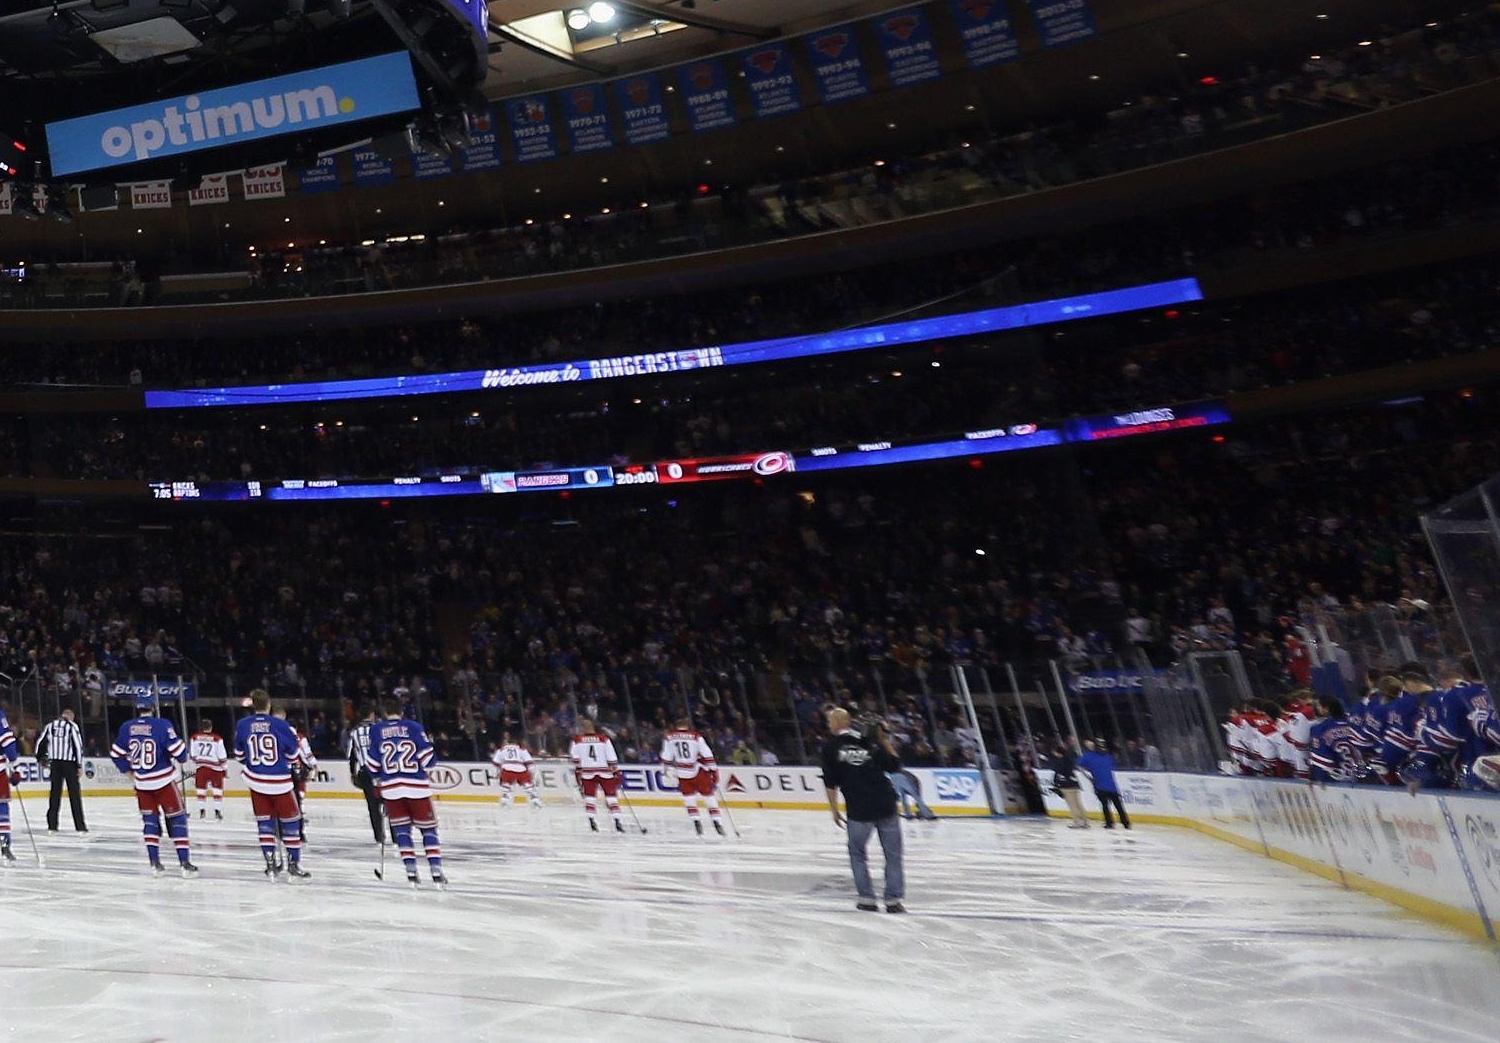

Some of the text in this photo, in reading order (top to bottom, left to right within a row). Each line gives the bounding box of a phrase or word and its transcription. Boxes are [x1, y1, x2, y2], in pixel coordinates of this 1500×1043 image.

[625, 104, 663, 119] 1971-72
[570, 114, 607, 128] 1970-71
[514, 124, 551, 137] 1952-53
[190, 186, 227, 201] KNICKS
[245, 180, 283, 197] KNICKS
[133, 191, 169, 205] KNICKS
[481, 368, 559, 388] Welcome
[562, 363, 582, 382] to
[583, 468, 598, 485] 0
[615, 471, 656, 486] 20:00
[666, 462, 683, 480] 0
[129, 738, 157, 769] 28
[248, 733, 278, 766] 19
[381, 740, 419, 774] 22
[588, 745, 597, 762] 4
[675, 741, 691, 759] 18
[936, 775, 981, 797] SAP
